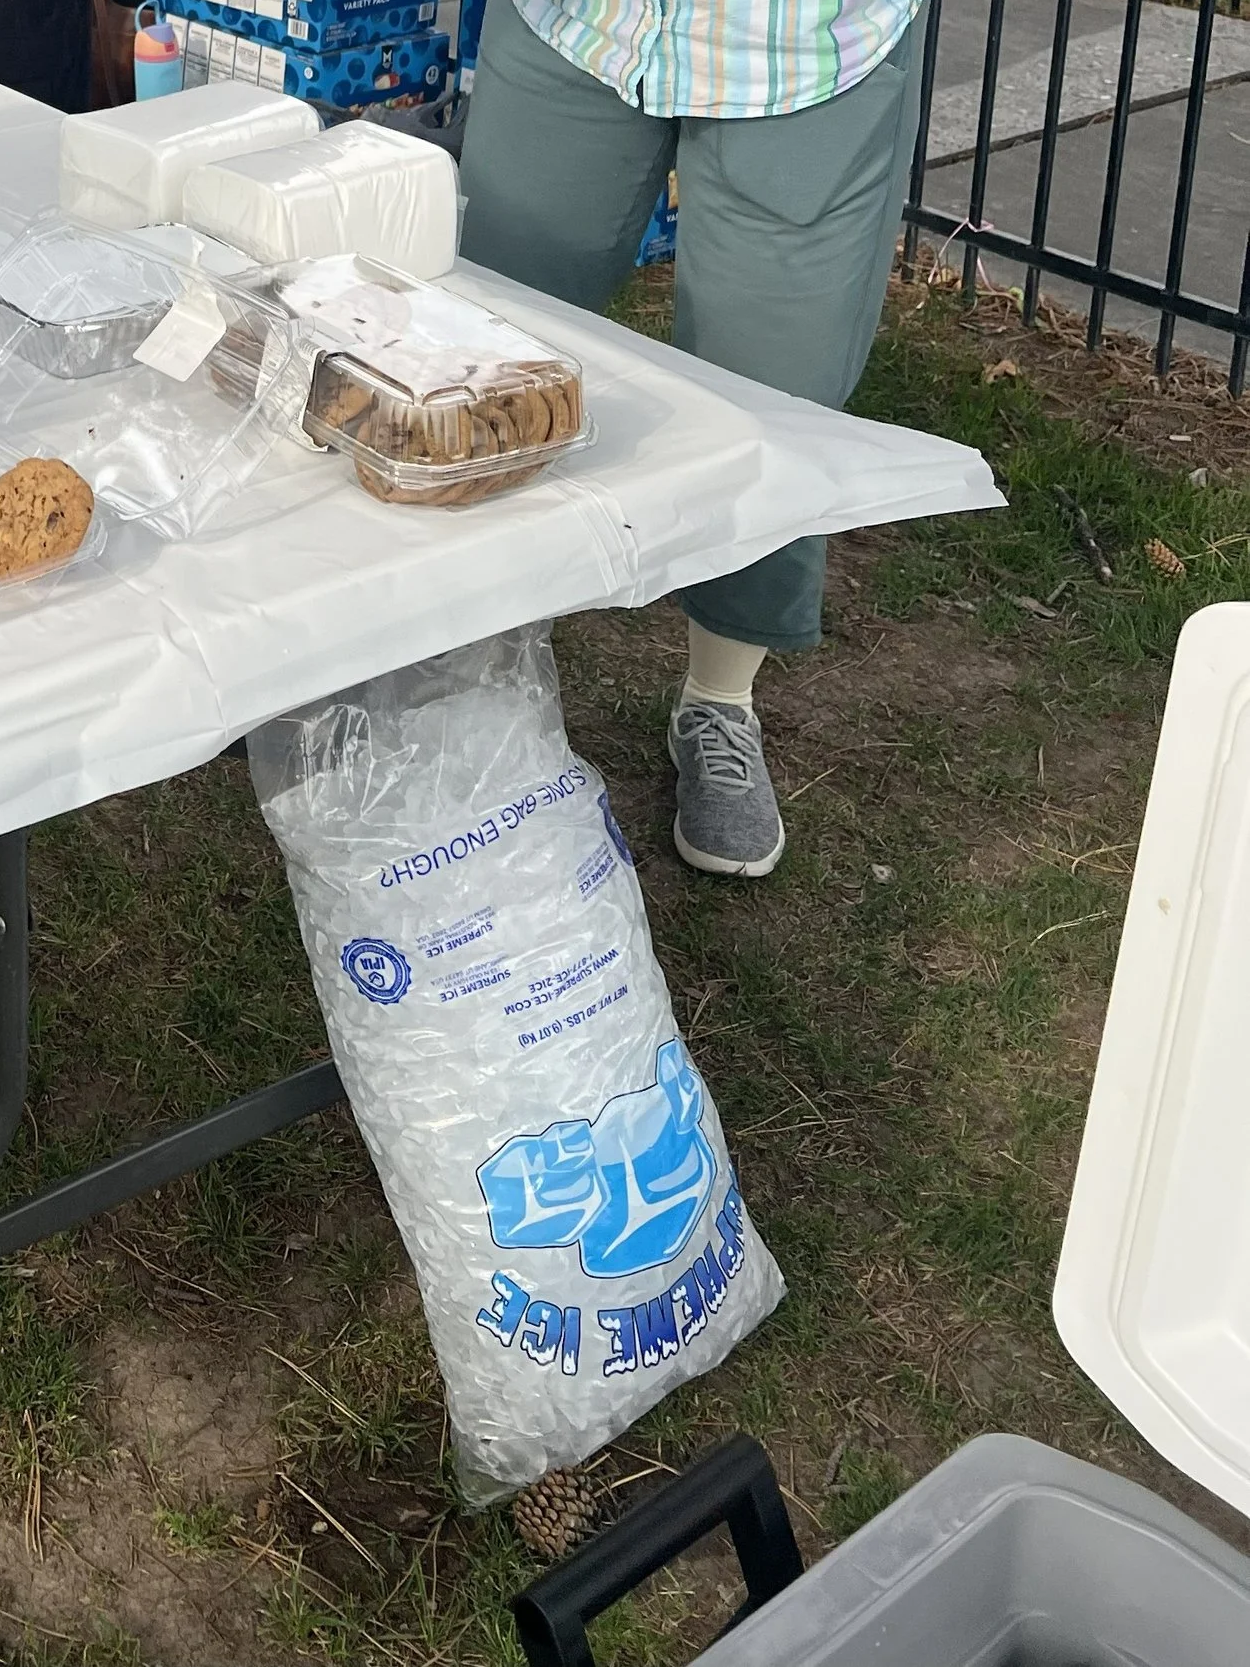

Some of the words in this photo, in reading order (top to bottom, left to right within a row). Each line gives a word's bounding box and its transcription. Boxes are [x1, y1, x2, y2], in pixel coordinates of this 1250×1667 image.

[380, 818, 500, 888] ENOUGH?
[578, 876, 595, 894] ICE
[448, 920, 494, 952] SUPREME
[426, 945, 444, 959] ICE
[360, 956, 386, 970] IPIA
[461, 968, 512, 996] SUPREME
[504, 948, 619, 1016] WWW.SUPREME-ICE.COM
[528, 952, 593, 994] 1-877-ICE-2ICE
[440, 988, 459, 1003] ICE
[613, 984, 628, 1002] NET
[586, 1004, 598, 1018] 20
[598, 995, 612, 1010] WT.
[562, 1011, 586, 1028] LBS.
[538, 1019, 563, 1040] (9.07
[518, 1031, 538, 1048] Kg)
[598, 1184, 745, 1376] UPREME
[476, 1270, 581, 1376] ICE
